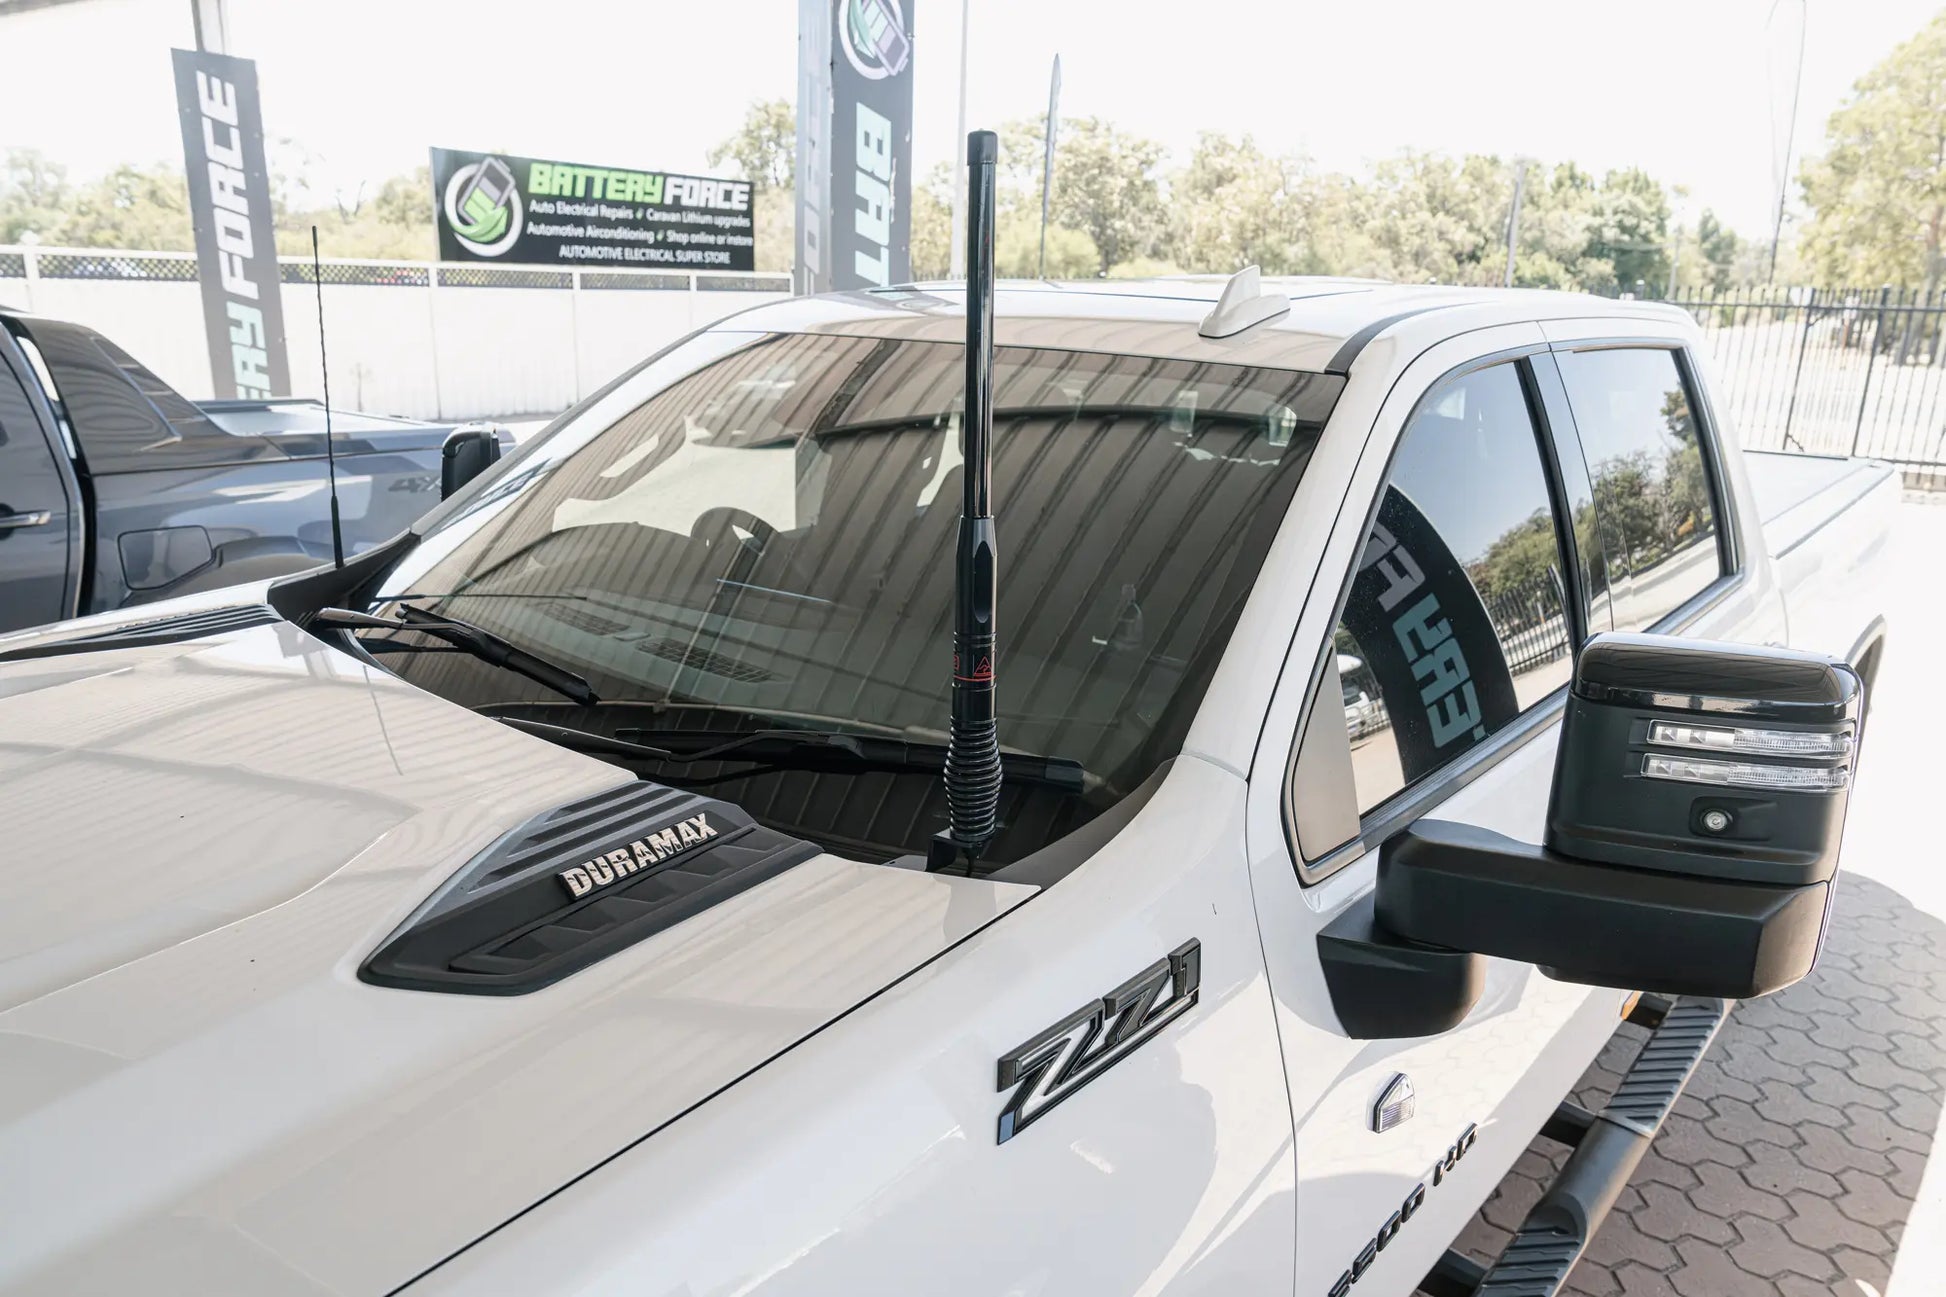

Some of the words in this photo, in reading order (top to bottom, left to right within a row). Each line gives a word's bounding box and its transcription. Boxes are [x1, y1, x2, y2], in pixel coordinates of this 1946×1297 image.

[196, 70, 260, 300] FORCE
[528, 162, 664, 204] BATTERY
[663, 176, 751, 211] FORCE
[527, 221, 585, 238] Automotive
[586, 225, 655, 244] Airconditioning
[666, 229, 690, 246] Shop
[690, 231, 716, 245] online
[716, 234, 726, 246] or
[529, 199, 555, 215] Auto
[556, 200, 599, 217] Electrical
[599, 204, 634, 221] Repairs
[646, 208, 681, 222] Caravan
[682, 210, 713, 225] Lithium
[714, 214, 751, 229] upgrades
[559, 244, 624, 261] AUTOMOTIVE
[624, 247, 675, 262] ELECTRICAL
[675, 249, 704, 264] SUPER
[704, 251, 731, 265] STORE
[558, 812, 719, 898] DURAMAX
[997, 936, 1202, 1146] Z71
[1432, 1122, 1478, 1187] HD
